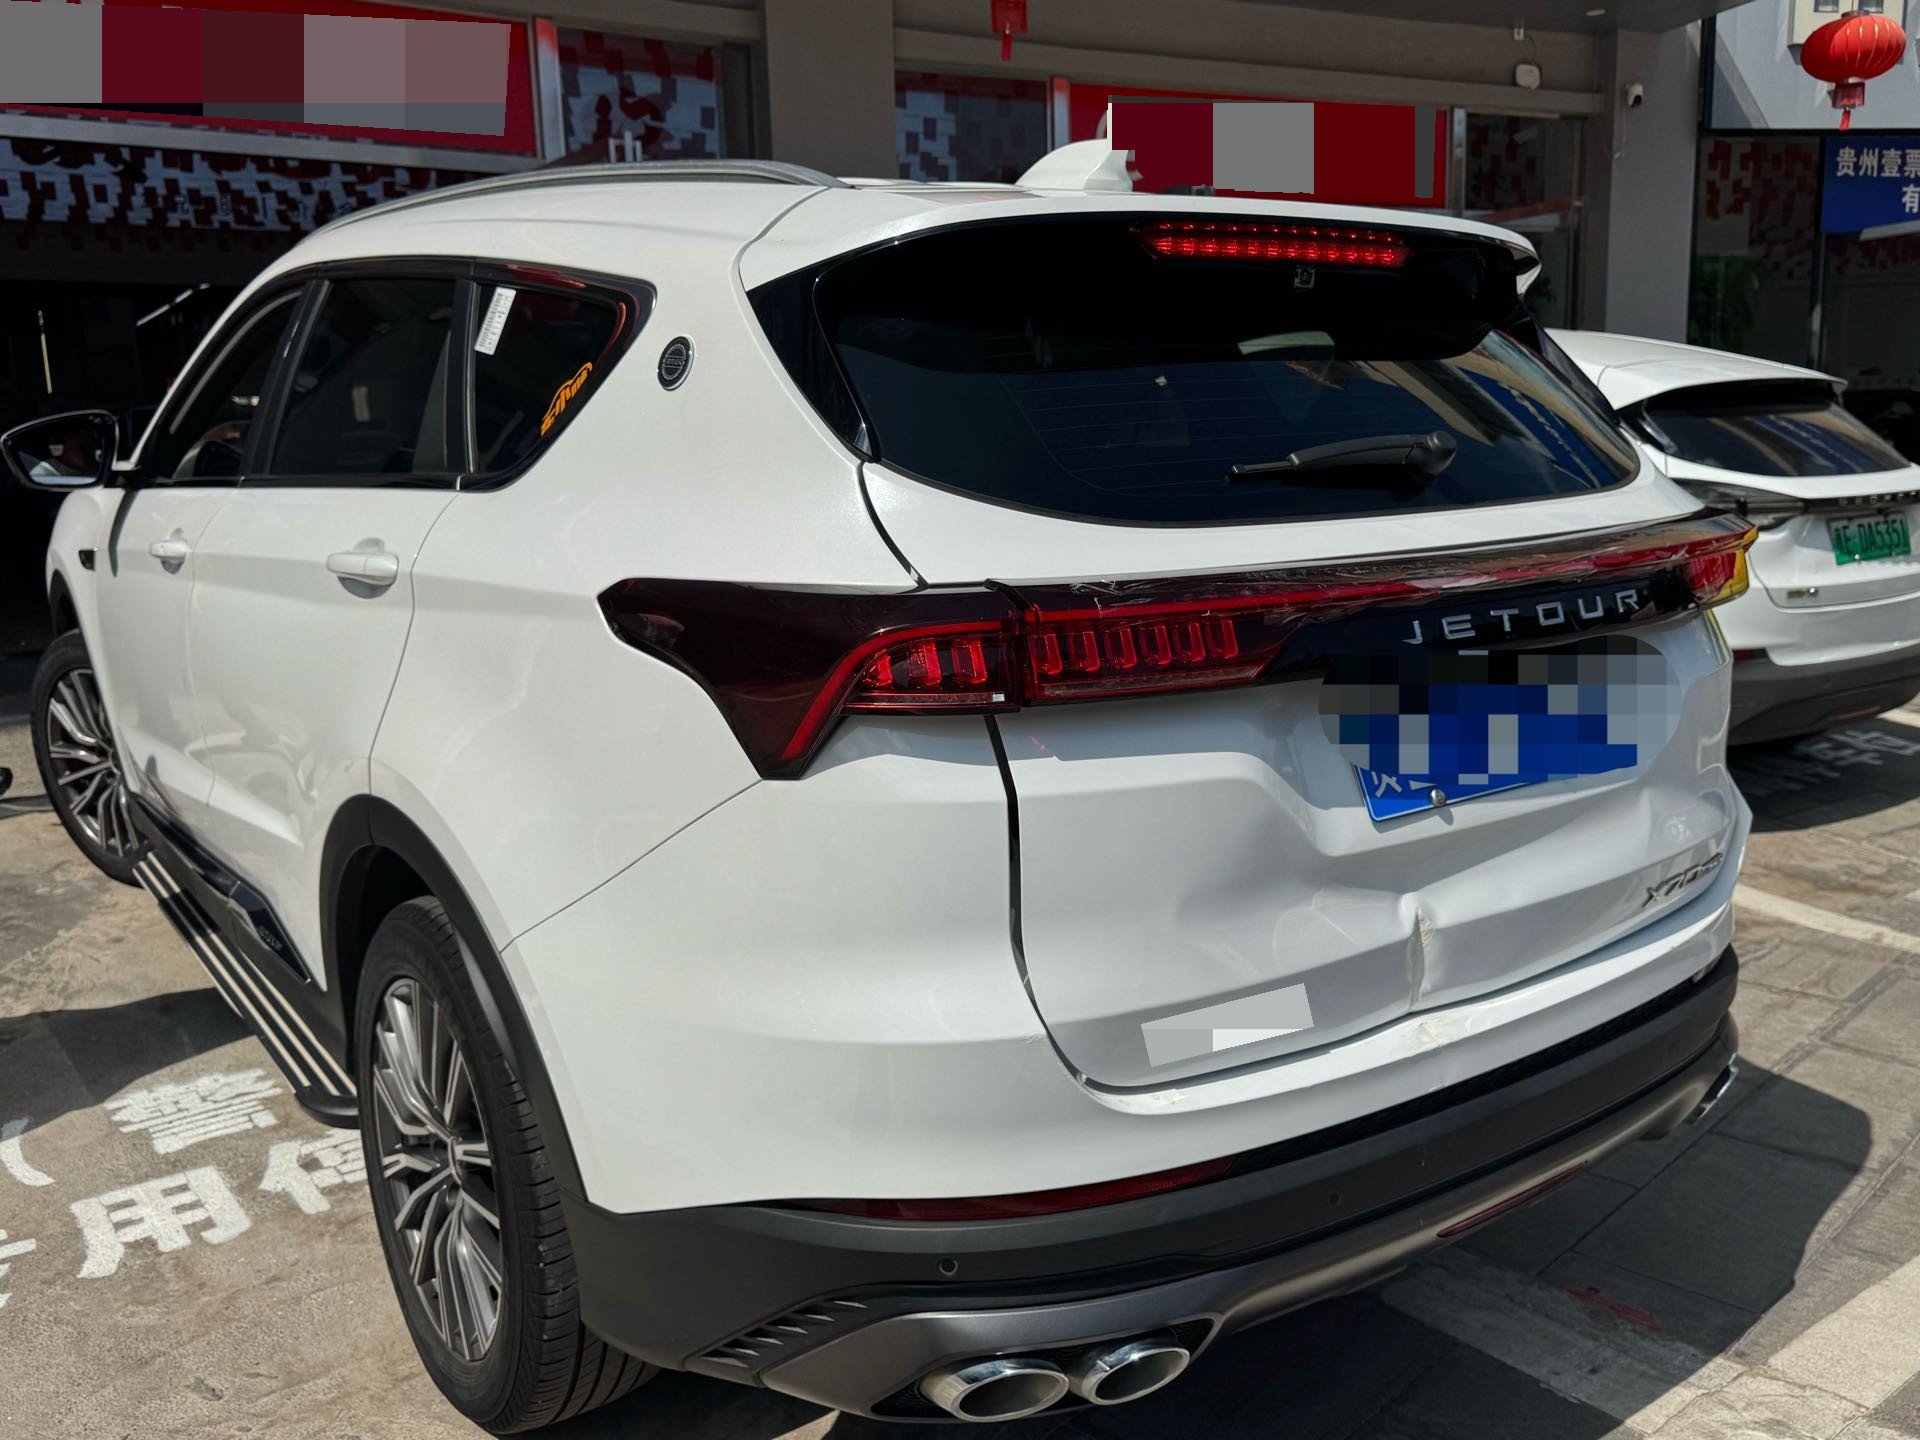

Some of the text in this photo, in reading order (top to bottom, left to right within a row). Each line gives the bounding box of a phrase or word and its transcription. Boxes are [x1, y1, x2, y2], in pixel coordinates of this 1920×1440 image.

[1836, 147, 1920, 178] 贵州壹票
[1902, 184, 1920, 213] 有
[1401, 589, 1639, 644] JETOUR
